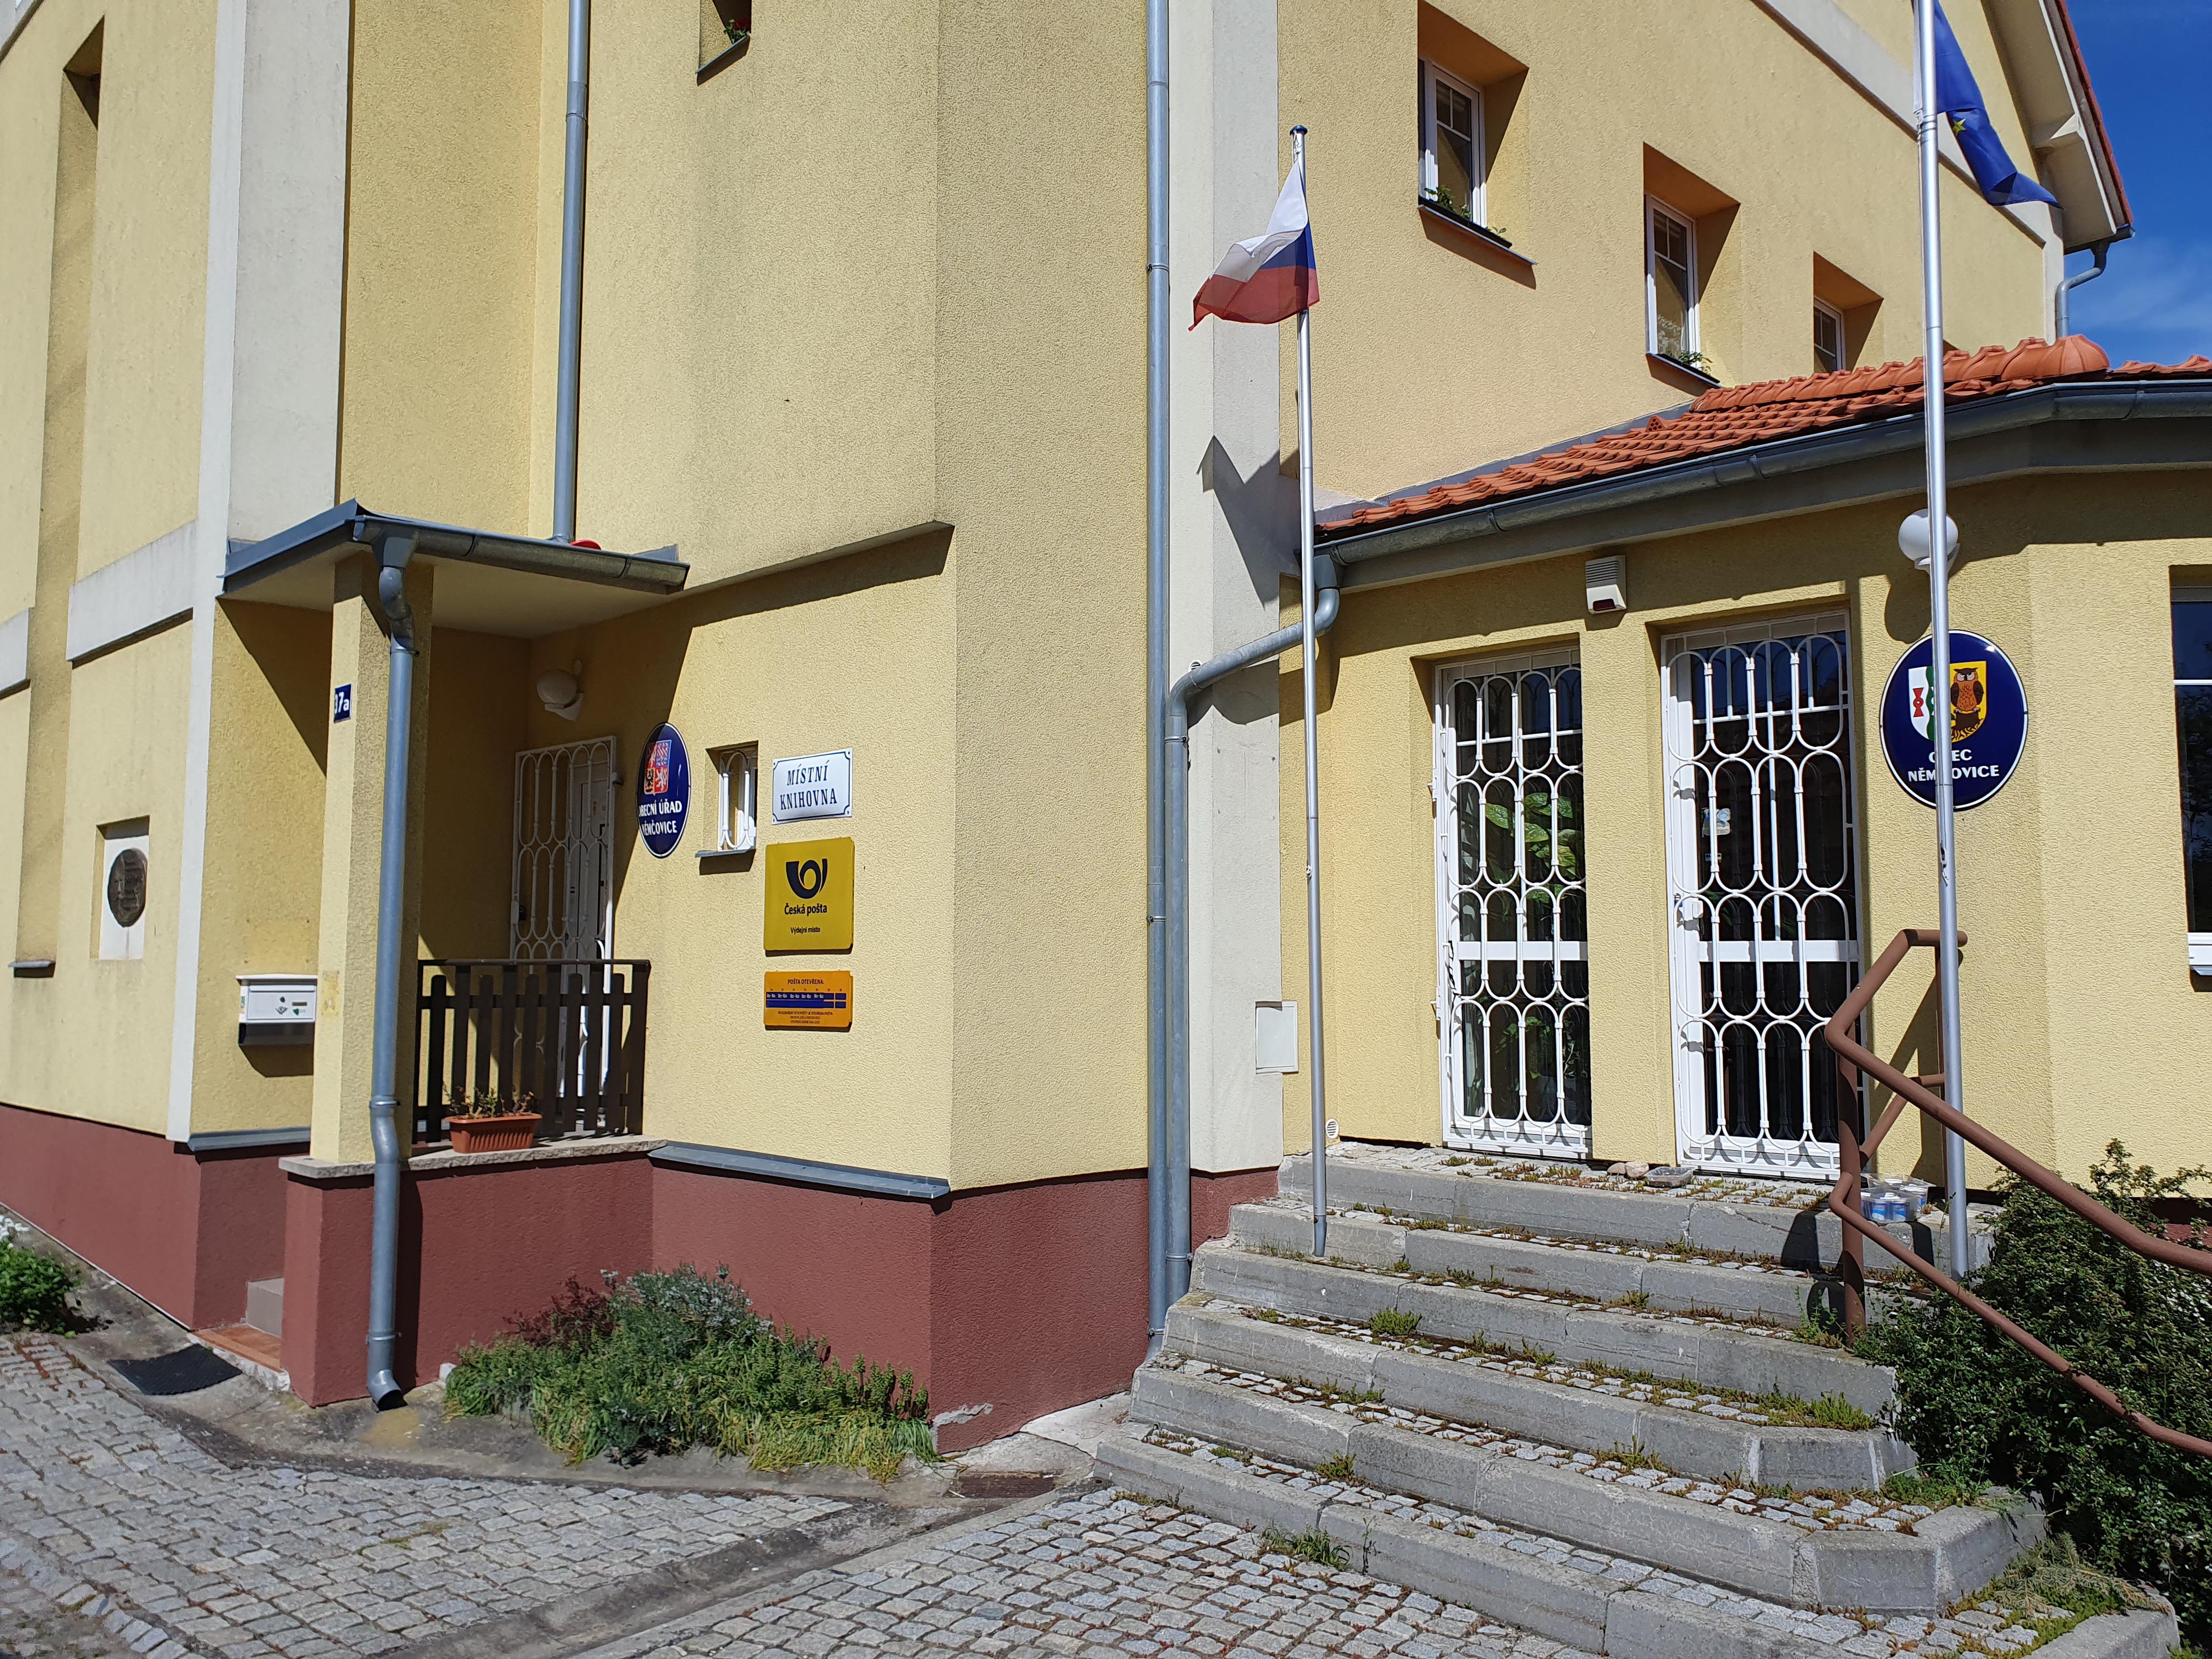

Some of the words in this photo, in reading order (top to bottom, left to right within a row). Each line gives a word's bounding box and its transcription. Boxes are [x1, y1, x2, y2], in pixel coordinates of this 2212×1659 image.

[787, 760, 830, 786] MÍSTNÍ
[1908, 765, 2000, 782] NĚMOVICE
[659, 798, 682, 815] ÚŘAD
[780, 788, 837, 810] KNIHOVNA
[784, 902, 805, 915] Česká
[807, 903, 827, 916] pošta
